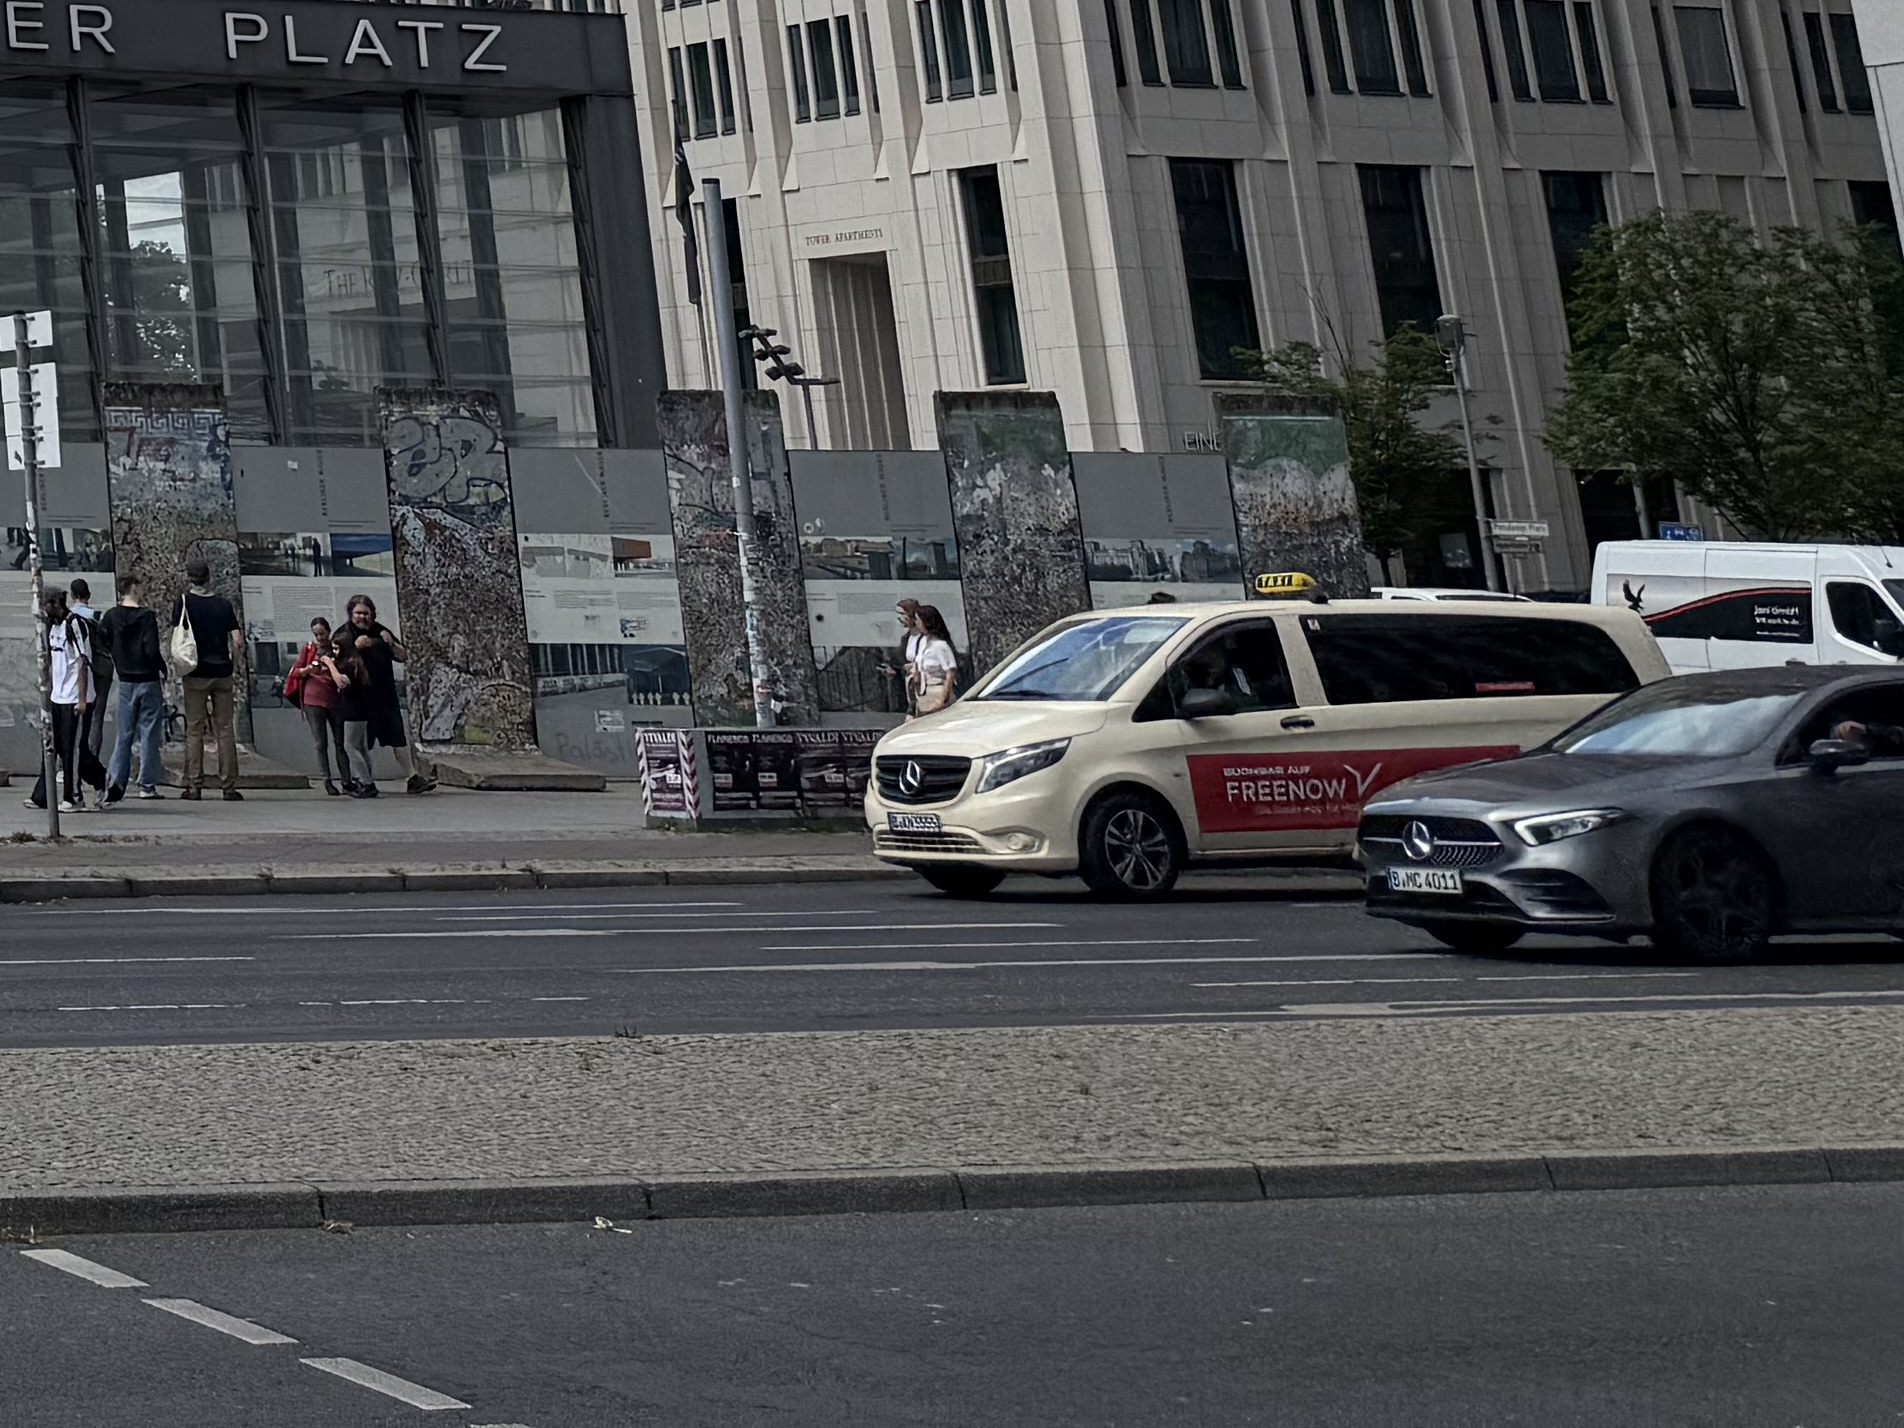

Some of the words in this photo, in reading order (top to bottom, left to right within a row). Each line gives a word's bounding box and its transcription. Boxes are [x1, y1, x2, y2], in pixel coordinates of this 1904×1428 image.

[224, 10, 510, 74] PLATZ
[1225, 777, 1346, 803] FREENOW
[1424, 872, 1459, 890] 4011
